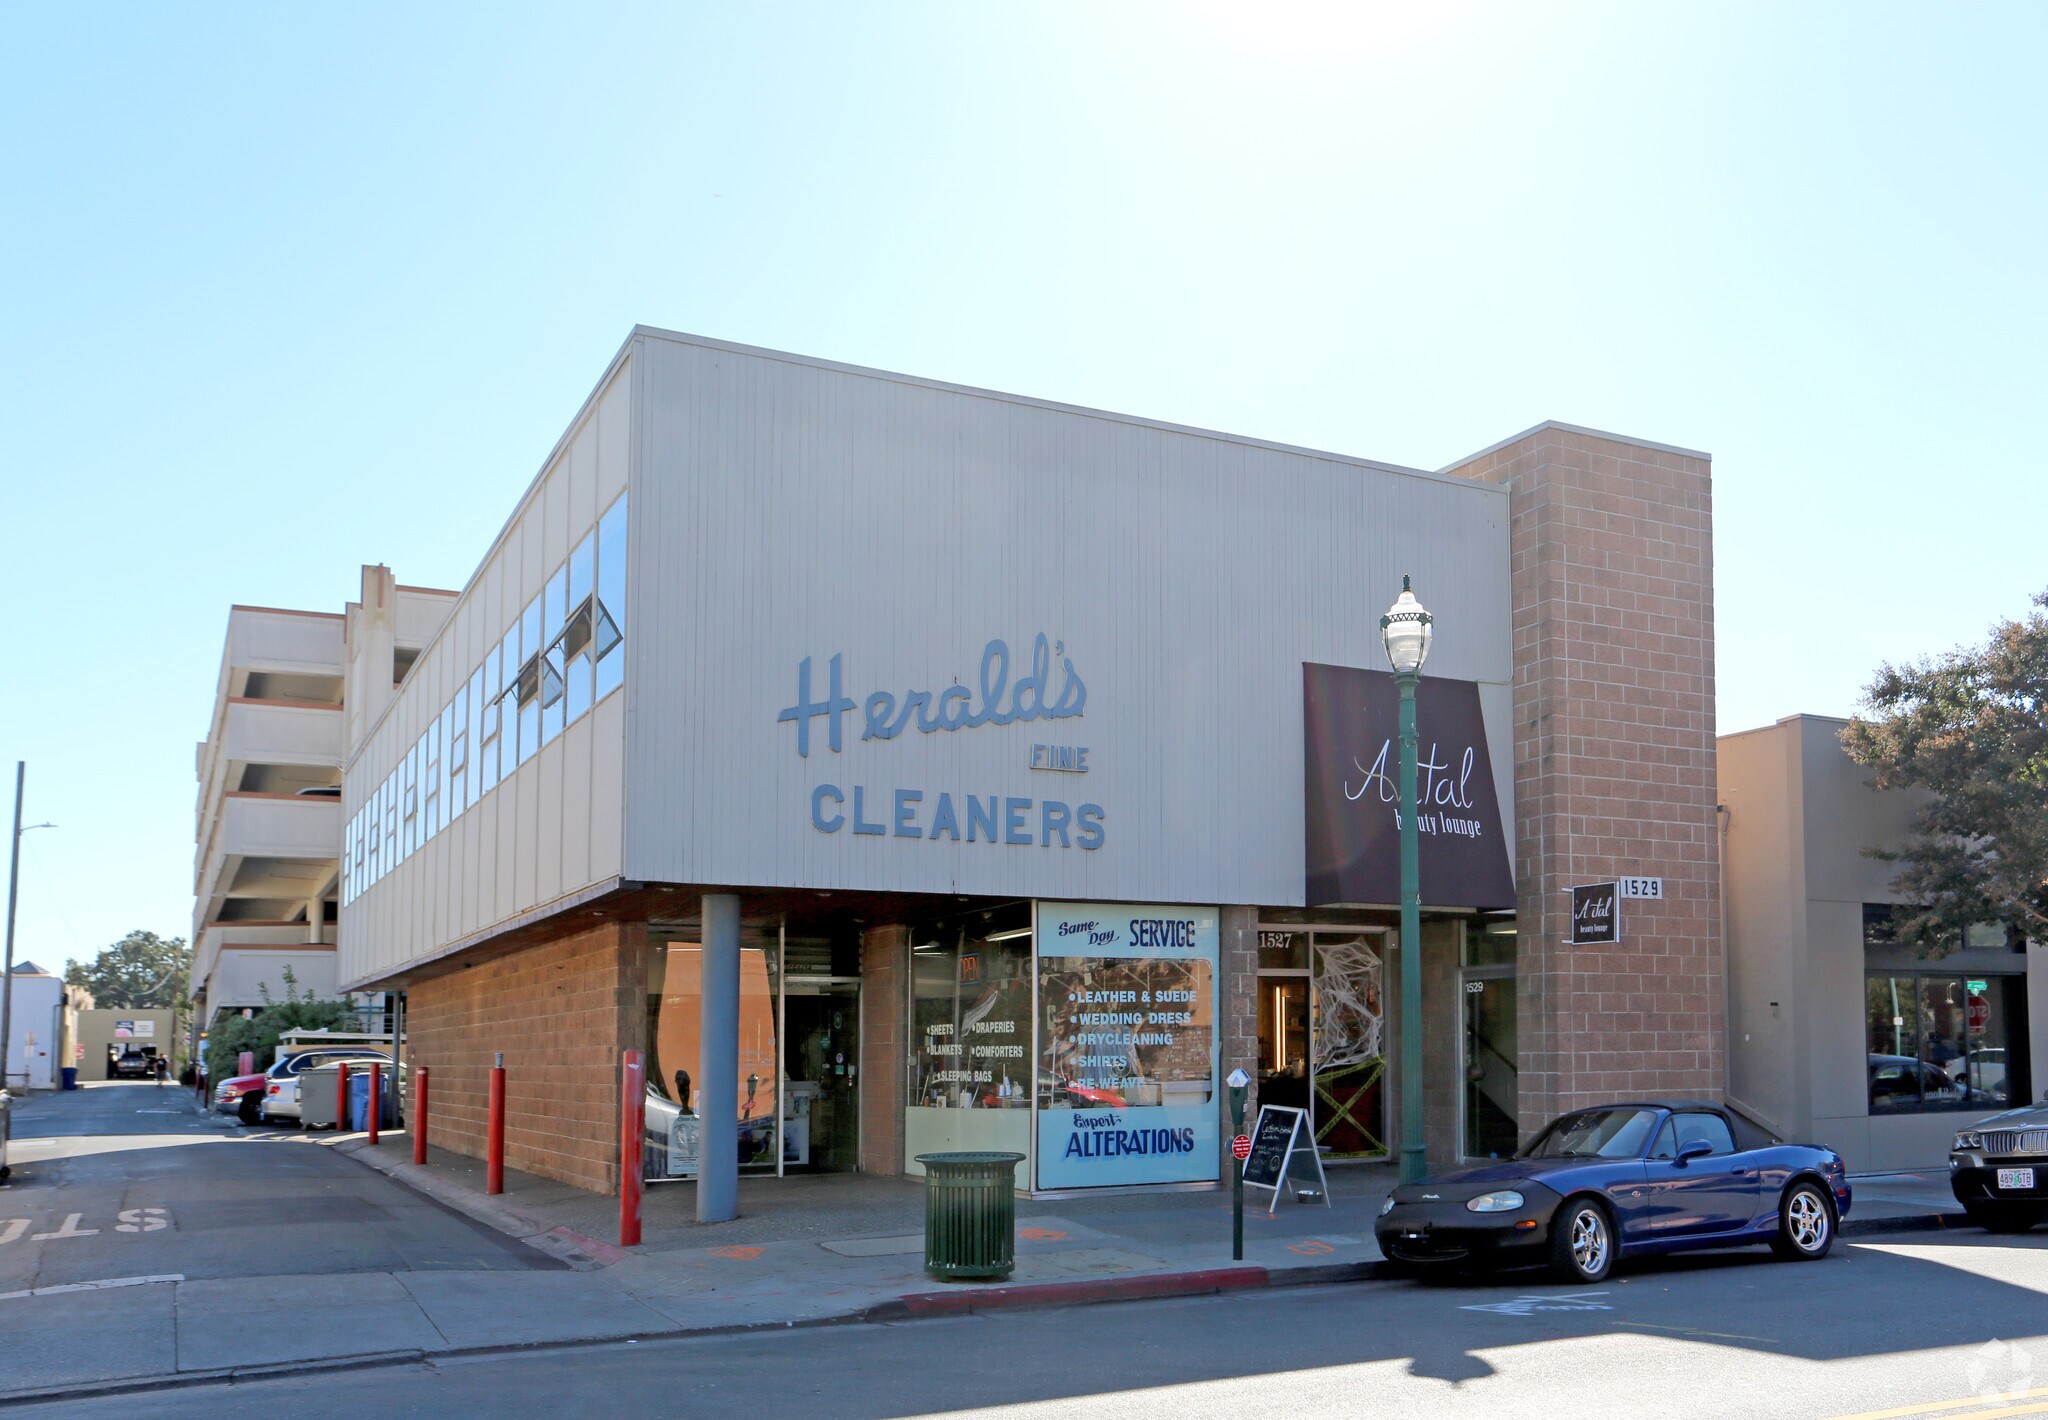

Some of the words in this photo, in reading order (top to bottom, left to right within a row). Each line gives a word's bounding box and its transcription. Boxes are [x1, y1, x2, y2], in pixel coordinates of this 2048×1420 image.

[778, 631, 1087, 758] Herald's
[1030, 743, 1089, 773] FINE
[1344, 739, 1474, 808] Atal
[811, 784, 1105, 850] CLEANERS
[1394, 808, 1437, 836] buty
[1439, 812, 1482, 838] lounge
[1624, 879, 1658, 896] 1529
[1058, 920, 1099, 937] Same
[1087, 929, 1120, 946] Day
[1129, 919, 1196, 947] SERVICE
[1594, 923, 1608, 933] lounge
[1259, 932, 1292, 949] 1527
[960, 956, 979, 982] OPEN
[1466, 981, 1484, 993] 1529
[1077, 991, 1137, 1004] LEATHER
[1140, 991, 1151, 1003] &
[1155, 990, 1197, 1003] SUEDE
[1079, 1012, 1142, 1025] WEDDING
[1149, 1012, 1192, 1024] DRESS
[930, 1024, 954, 1036] SHEETS
[976, 1021, 1015, 1034] DRAPERIES
[1077, 1032, 1174, 1046] DRYCLEANING
[930, 1044, 963, 1056] BLANKETS
[975, 1045, 1024, 1058] COMFORTERS
[1079, 1055, 1128, 1068] SHIRTS
[941, 1070, 972, 1082] SLEEPING
[974, 1070, 993, 1083] BAGS
[1066, 1127, 1194, 1157] ALTERATIONS
[2000, 1173, 2014, 1184] 489
